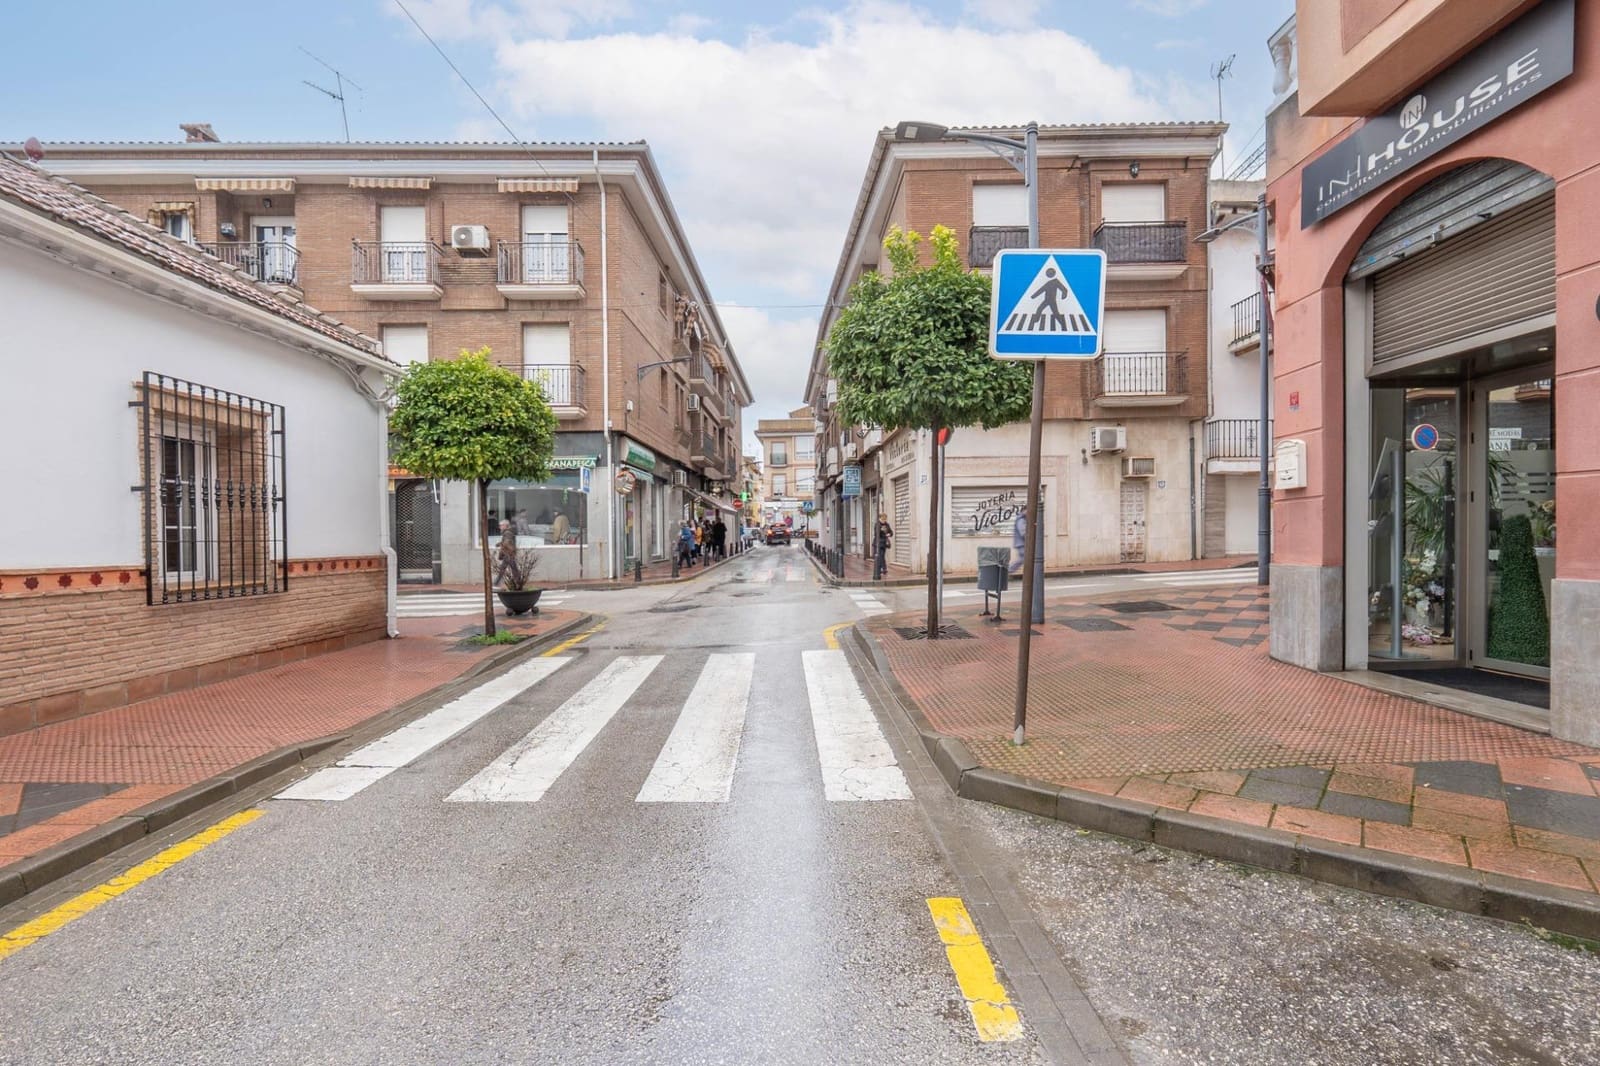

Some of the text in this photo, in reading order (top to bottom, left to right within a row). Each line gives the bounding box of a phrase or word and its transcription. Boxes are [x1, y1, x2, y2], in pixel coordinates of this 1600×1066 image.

[1316, 71, 1542, 212] consultores inmobiliarios
[976, 490, 1016, 512] JOYERIA
